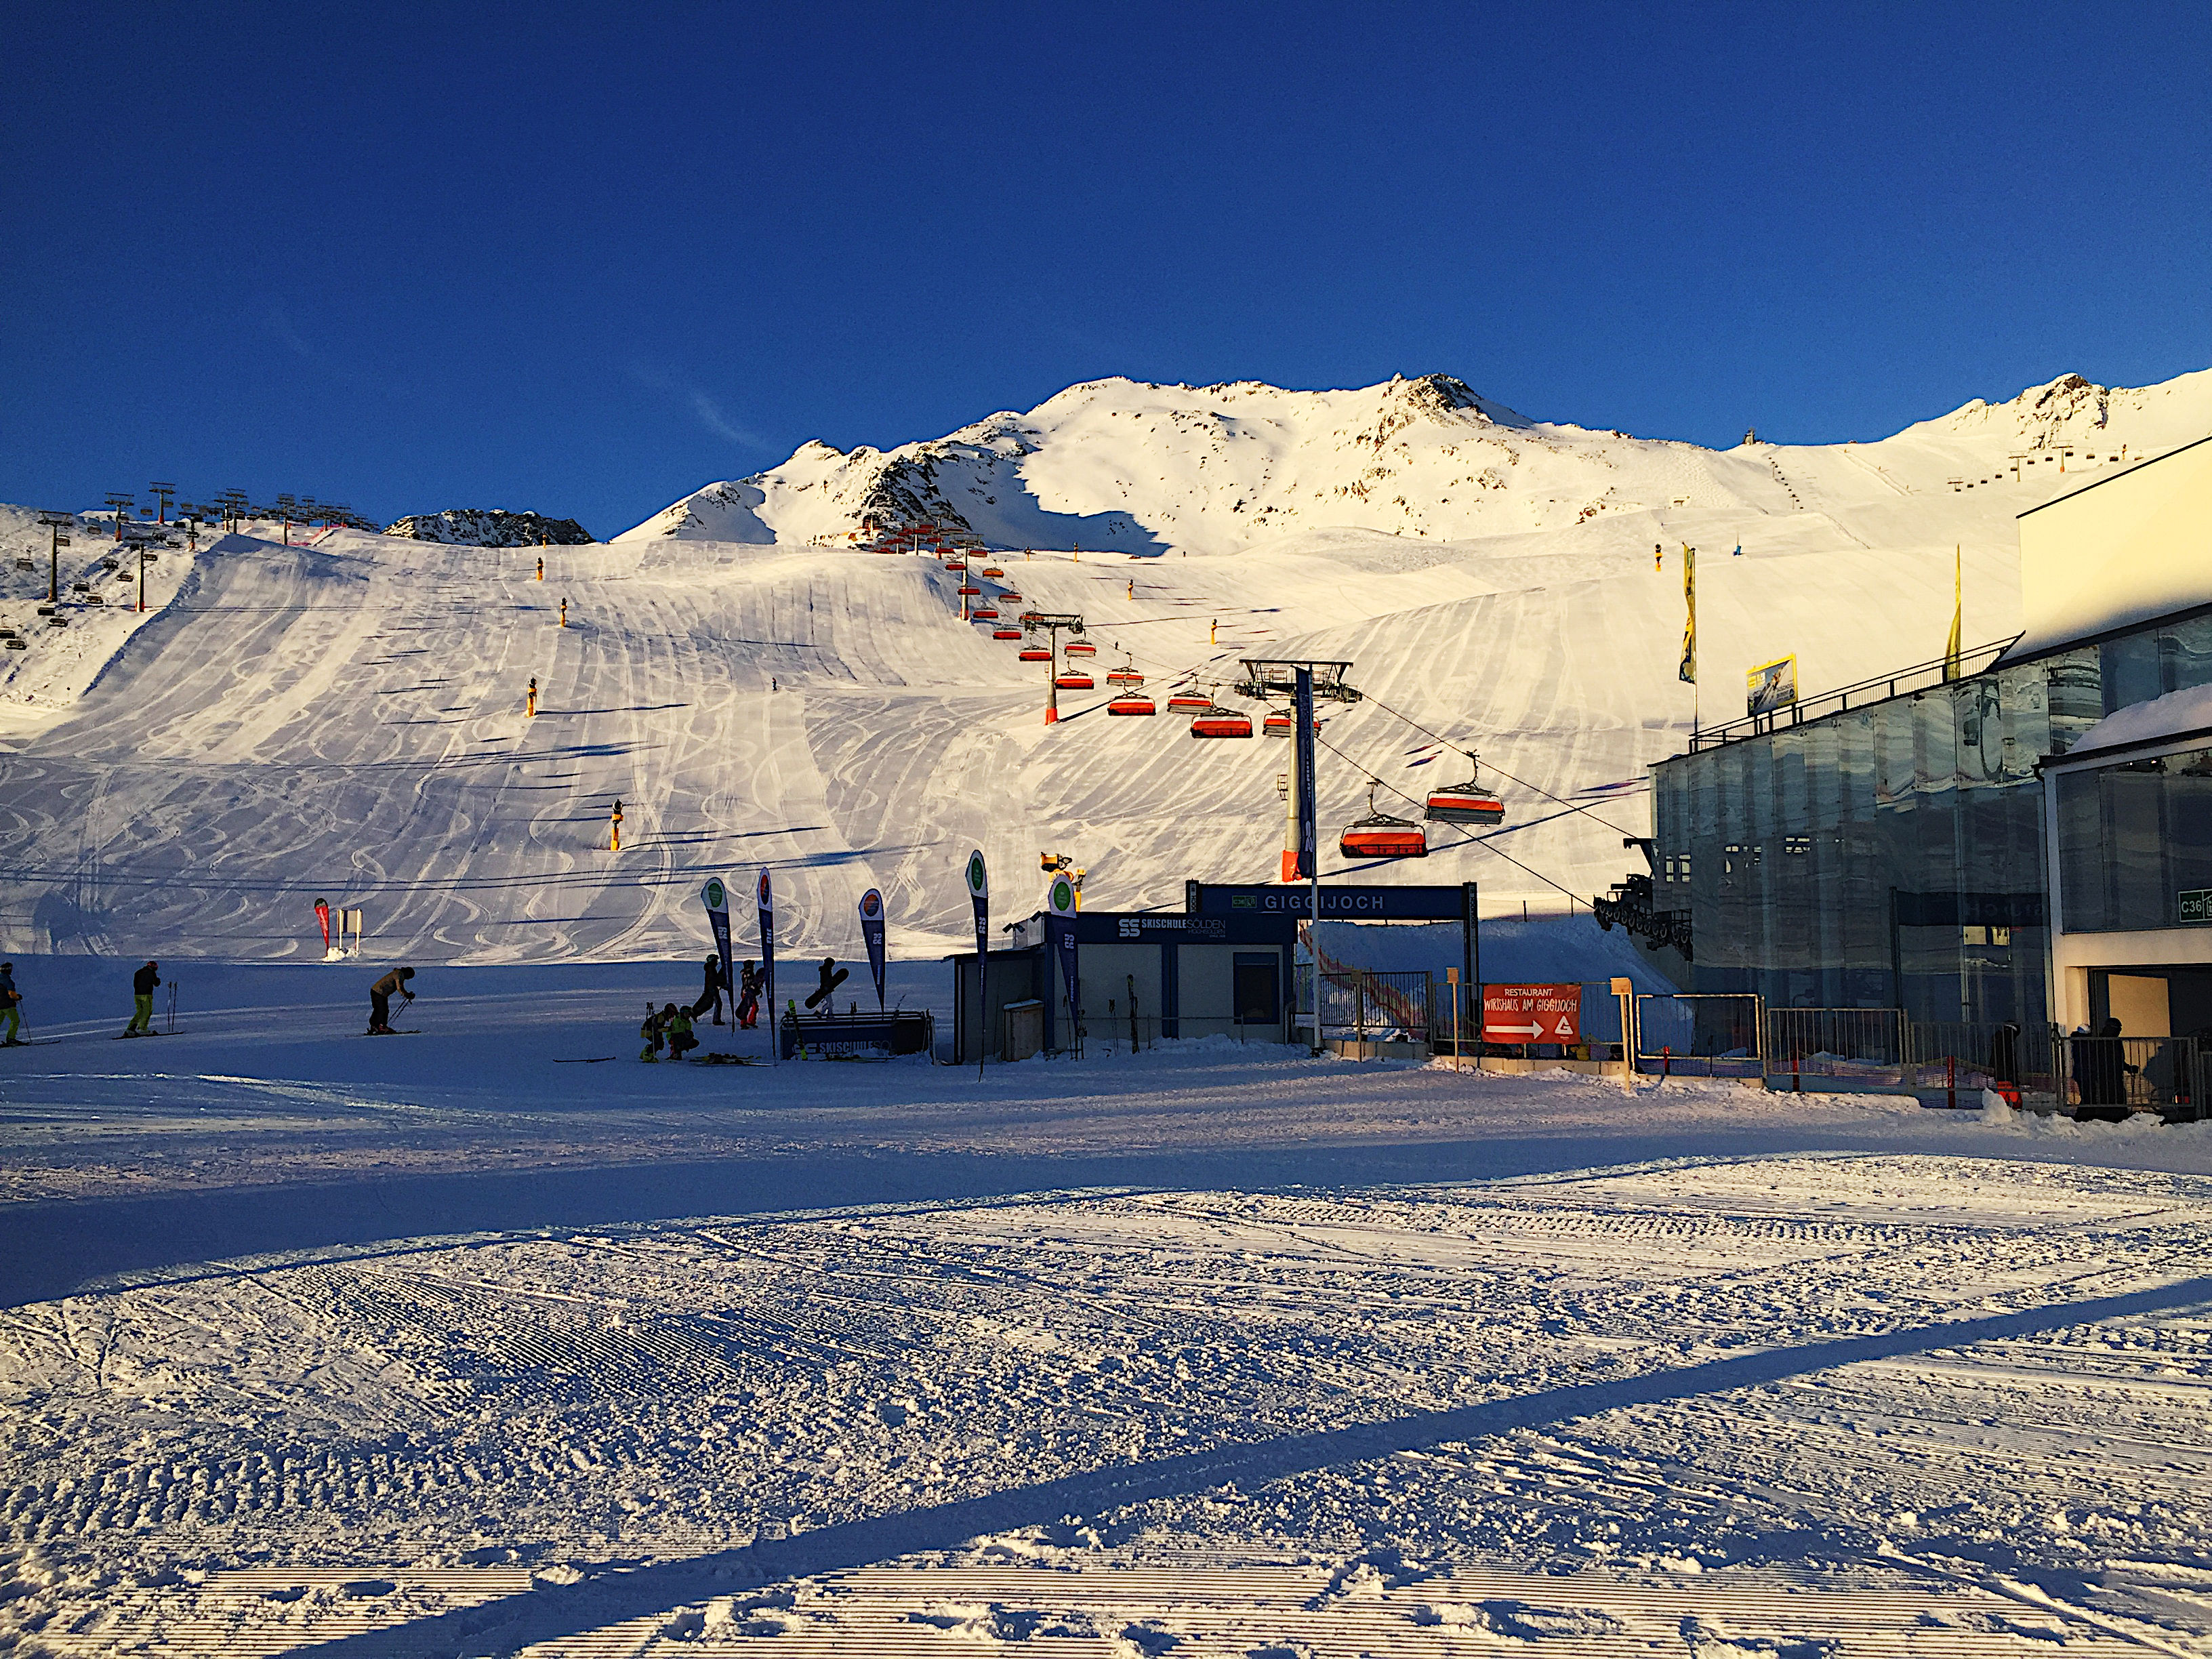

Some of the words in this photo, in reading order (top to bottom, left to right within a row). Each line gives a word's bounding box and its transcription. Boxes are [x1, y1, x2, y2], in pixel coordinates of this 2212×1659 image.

[1265, 895, 1383, 909] GIGGIJOCH
[2181, 900, 2203, 913] C36
[1504, 988, 1554, 996] RESTAURANT
[1483, 998, 1519, 1012] WIRTSHAUS
[1522, 998, 1534, 1012] AM
[1536, 999, 1578, 1012] GIGGIJOCH
